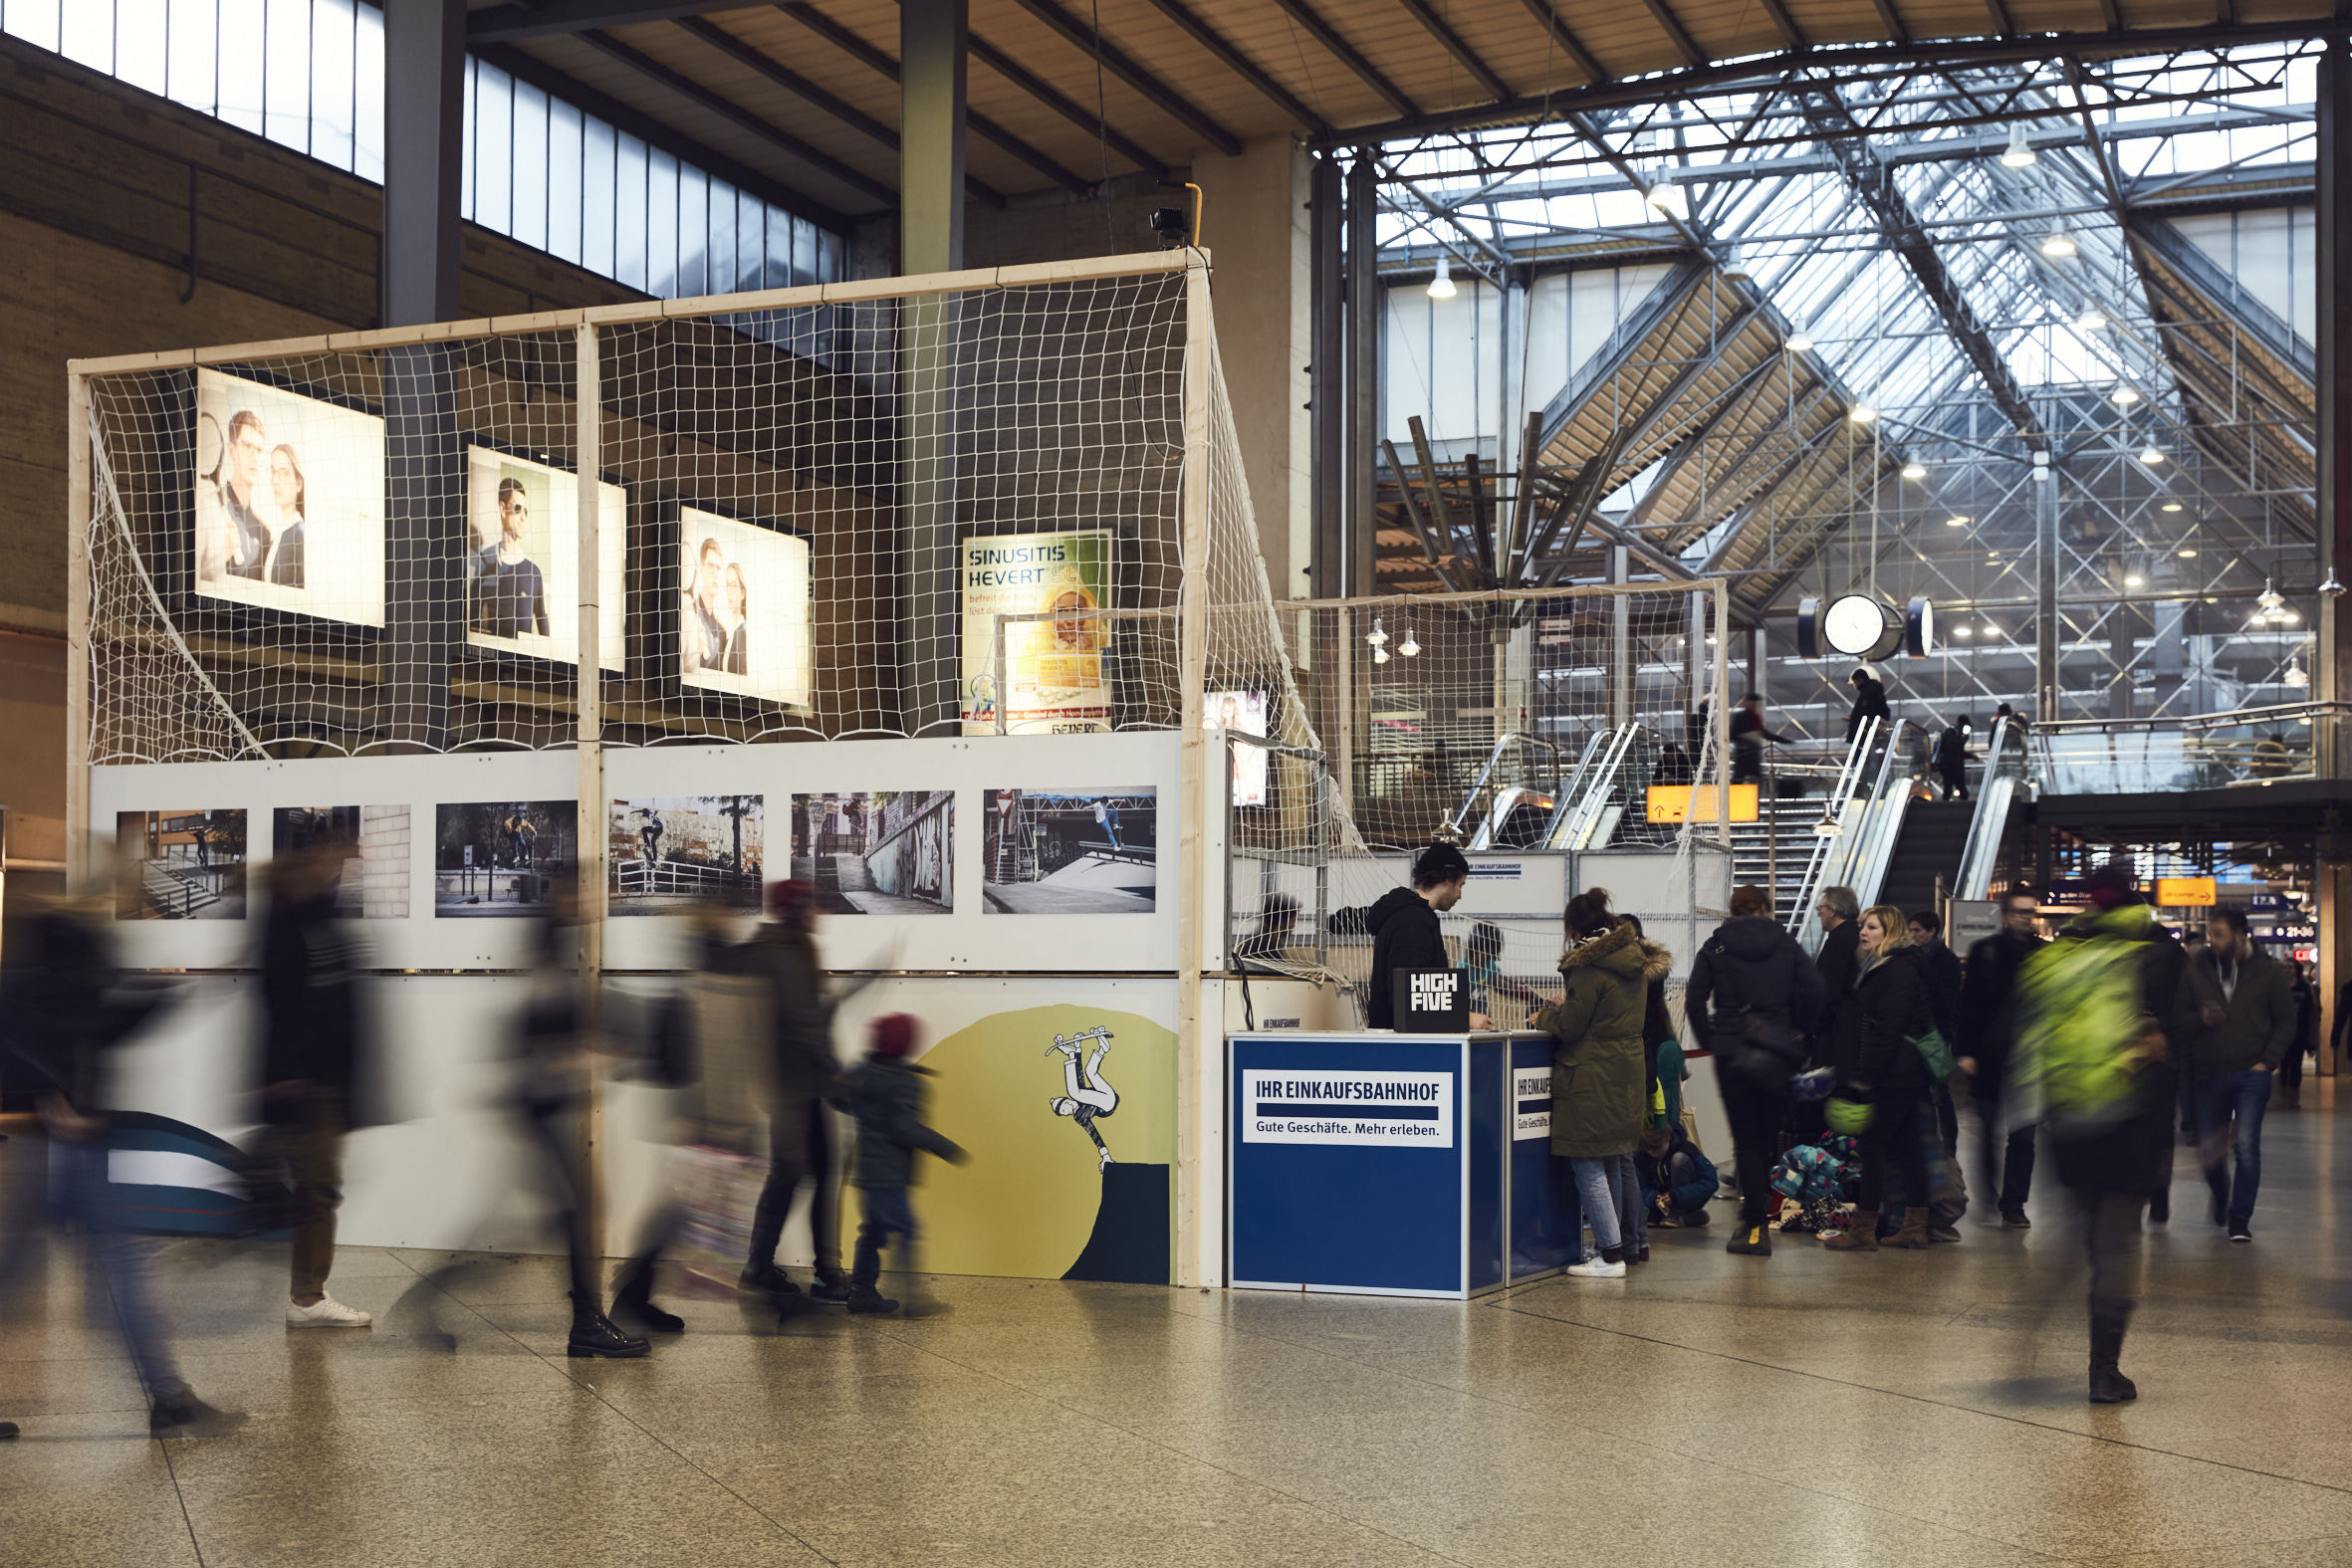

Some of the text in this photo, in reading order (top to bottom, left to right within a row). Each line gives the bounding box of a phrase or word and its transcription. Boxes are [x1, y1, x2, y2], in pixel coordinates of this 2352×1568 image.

[969, 545, 1065, 565] SINUSITIS
[969, 567, 1045, 586] HEVERT
[1410, 973, 1458, 993] HIGH
[1410, 992, 1453, 1011] FIVE
[1256, 1080, 1440, 1101] IHR EINKAUFSBAHNHOF
[1518, 1078, 1529, 1095] IHR
[1256, 1120, 1440, 1137] Gute Geschäfte. Mehr erleben.
